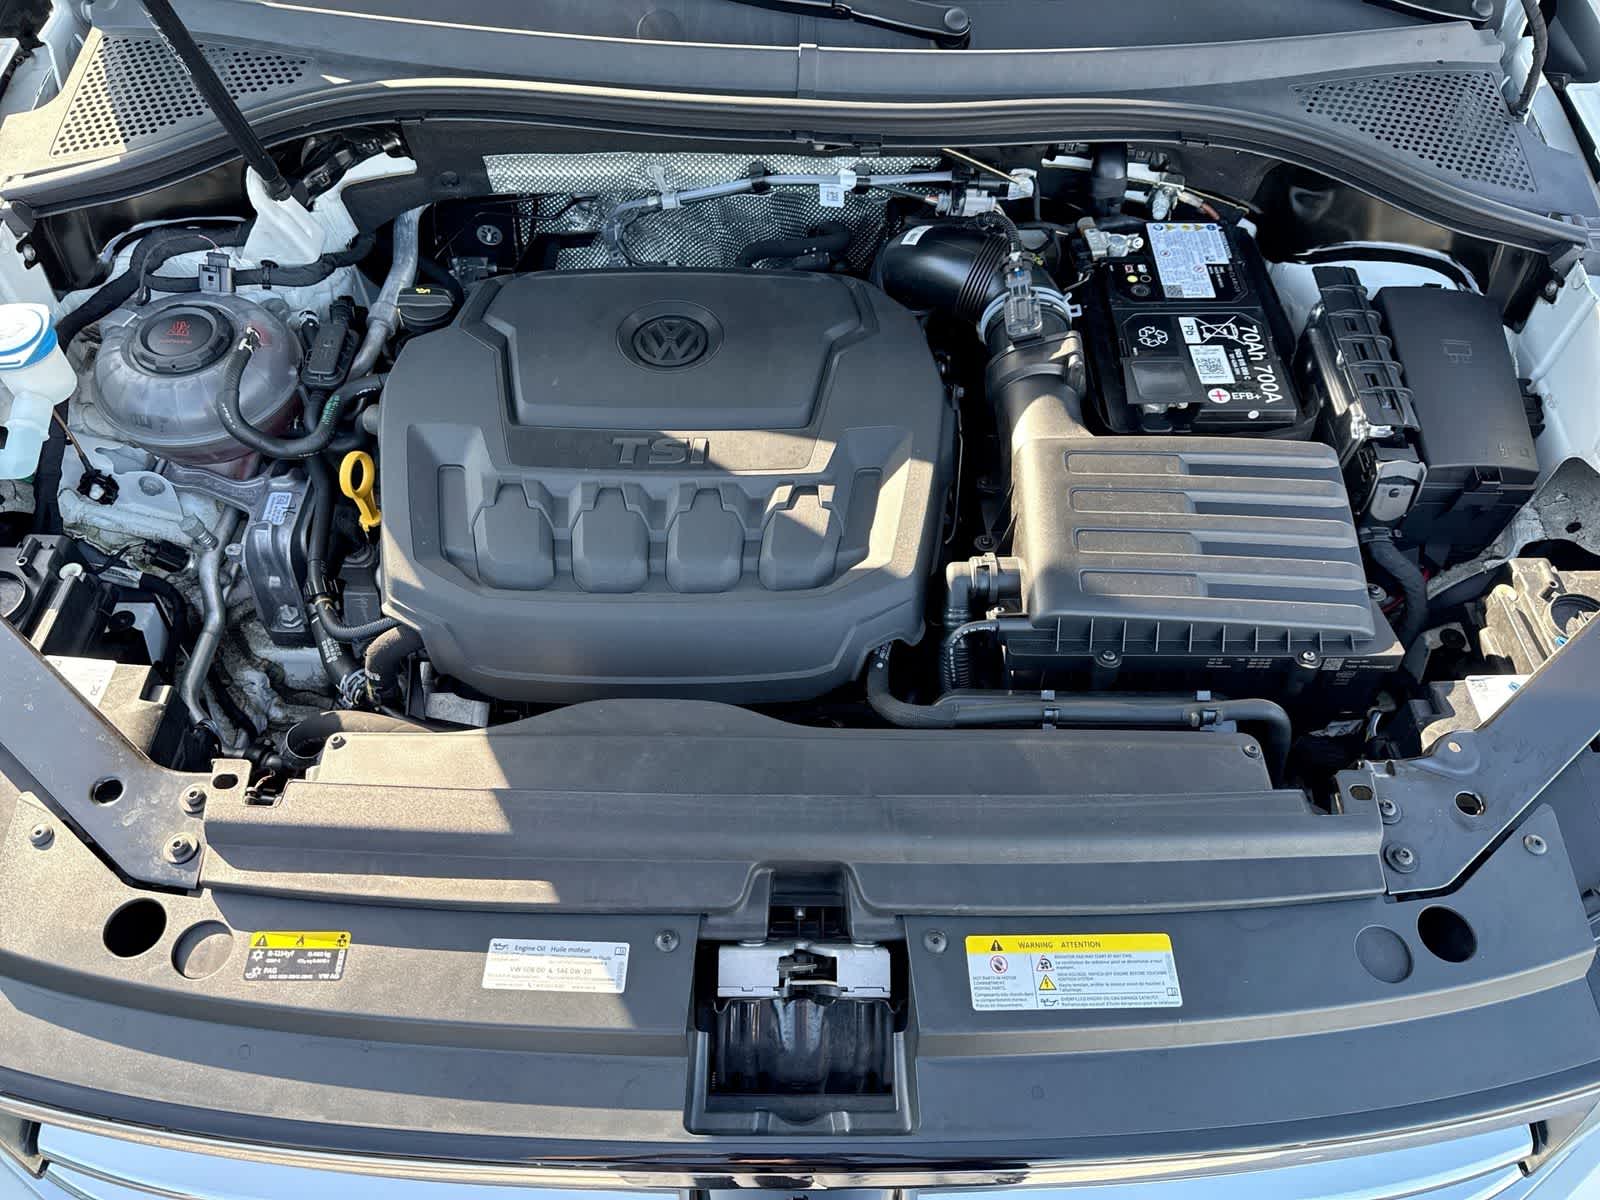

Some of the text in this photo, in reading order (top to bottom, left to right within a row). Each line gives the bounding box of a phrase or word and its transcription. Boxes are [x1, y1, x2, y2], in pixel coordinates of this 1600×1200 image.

[1183, 324, 1194, 336] Pb
[1239, 325, 1267, 361] 70Ah
[1253, 365, 1283, 404] 700A
[1231, 391, 1261, 400] EFB+
[612, 437, 709, 464] TSI
[514, 944, 536, 952] Engine
[536, 944, 547, 952] Oil
[1017, 940, 1101, 949] WARNING ATTENTION
